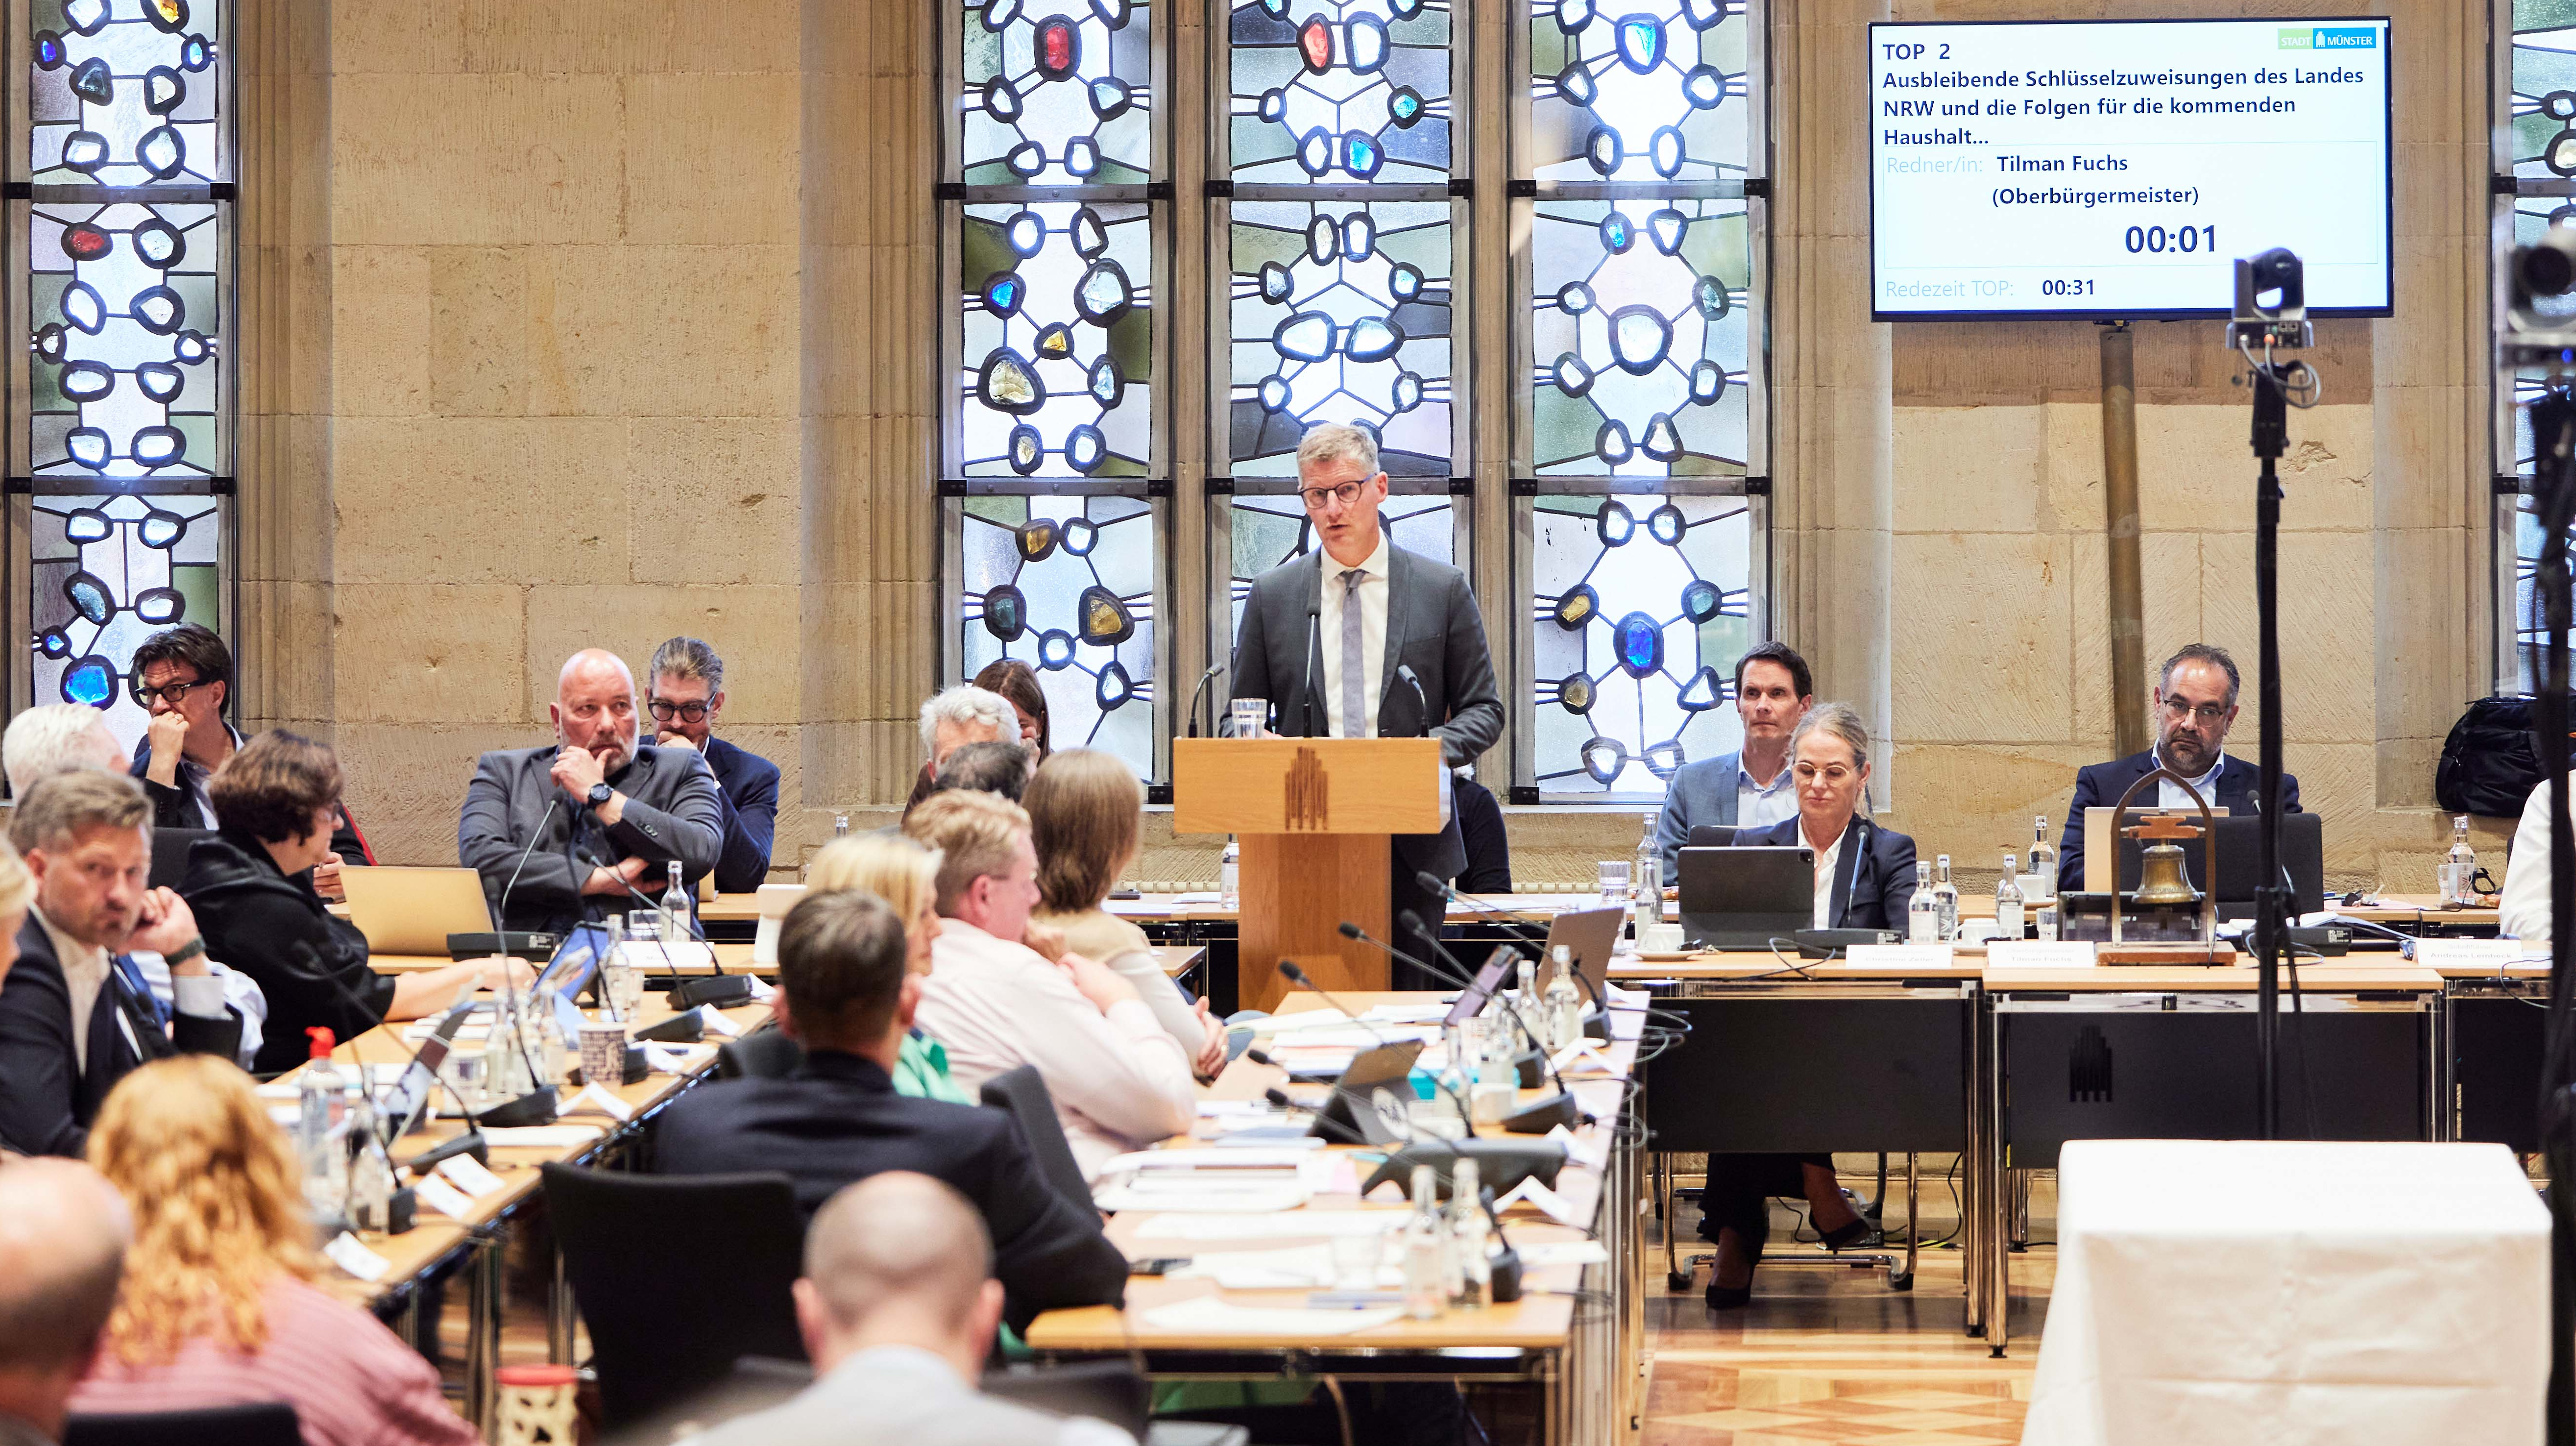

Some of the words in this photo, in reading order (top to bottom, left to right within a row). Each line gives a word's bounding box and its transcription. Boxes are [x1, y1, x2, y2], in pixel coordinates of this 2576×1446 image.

[2281, 37, 2311, 46] STADT
[2327, 35, 2373, 46] MÜNSTER
[1883, 44, 1925, 60] TOP
[1940, 44, 1950, 60] 2
[1883, 71, 2019, 88] Ausbleibende
[2026, 69, 2246, 89] Schlüsselzuweisungen
[2254, 68, 2287, 84] des
[2295, 67, 2363, 83] Landes
[1884, 101, 1935, 117] NRW
[1942, 99, 1979, 116] und
[1987, 99, 2017, 116] die
[2024, 98, 2090, 120] Folgen
[2097, 98, 2127, 114] für
[2134, 98, 2163, 114] die
[2171, 96, 2295, 114] kommenden
[1884, 128, 1989, 145] Haushalt...
[1887, 155, 1982, 174] Redner/in:
[1997, 155, 2065, 172] Tilman
[2073, 154, 2128, 171] Fuchs
[1993, 187, 2198, 208] (Oberbürgermeister)
[2126, 225, 2215, 253] 00:01
[1886, 280, 1966, 298] Redezeit
[1971, 280, 2014, 297] TOP:
[2042, 279, 2094, 295] 00:31
